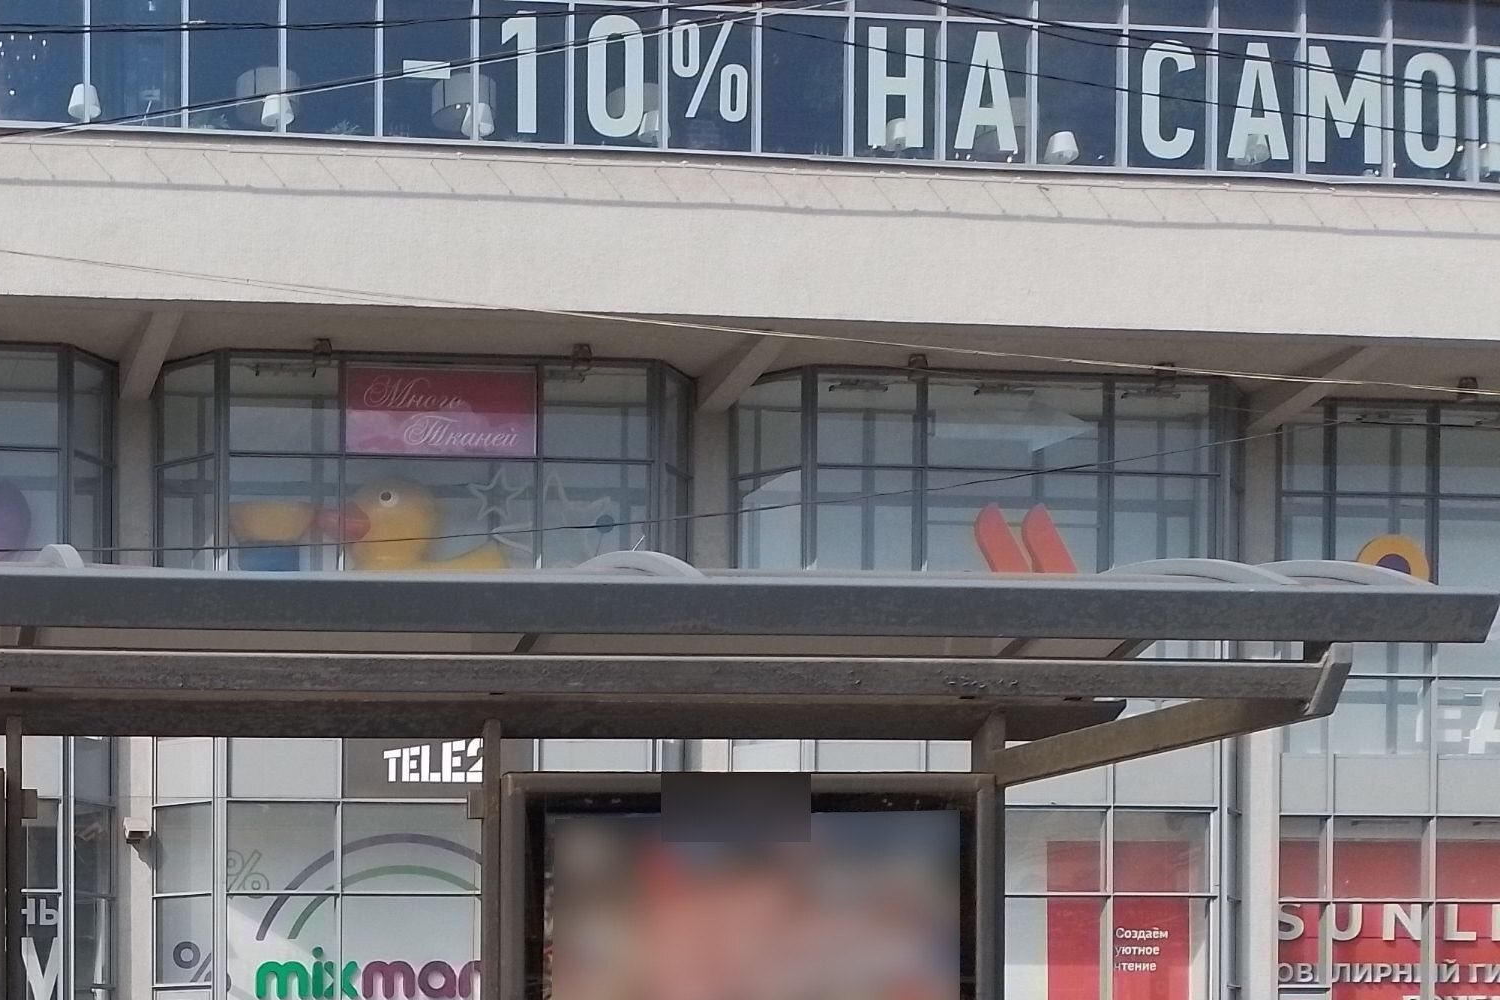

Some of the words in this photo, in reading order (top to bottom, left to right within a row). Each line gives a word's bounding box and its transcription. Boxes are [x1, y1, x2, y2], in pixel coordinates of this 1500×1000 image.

[867, 26, 1018, 152] НА
[1140, 39, 1500, 170] САМО
[383, 738, 483, 783] TELE2
[1115, 927, 1169, 941] Создаём
[1115, 945, 1160, 957] уютное
[1114, 961, 1157, 972] чтение
